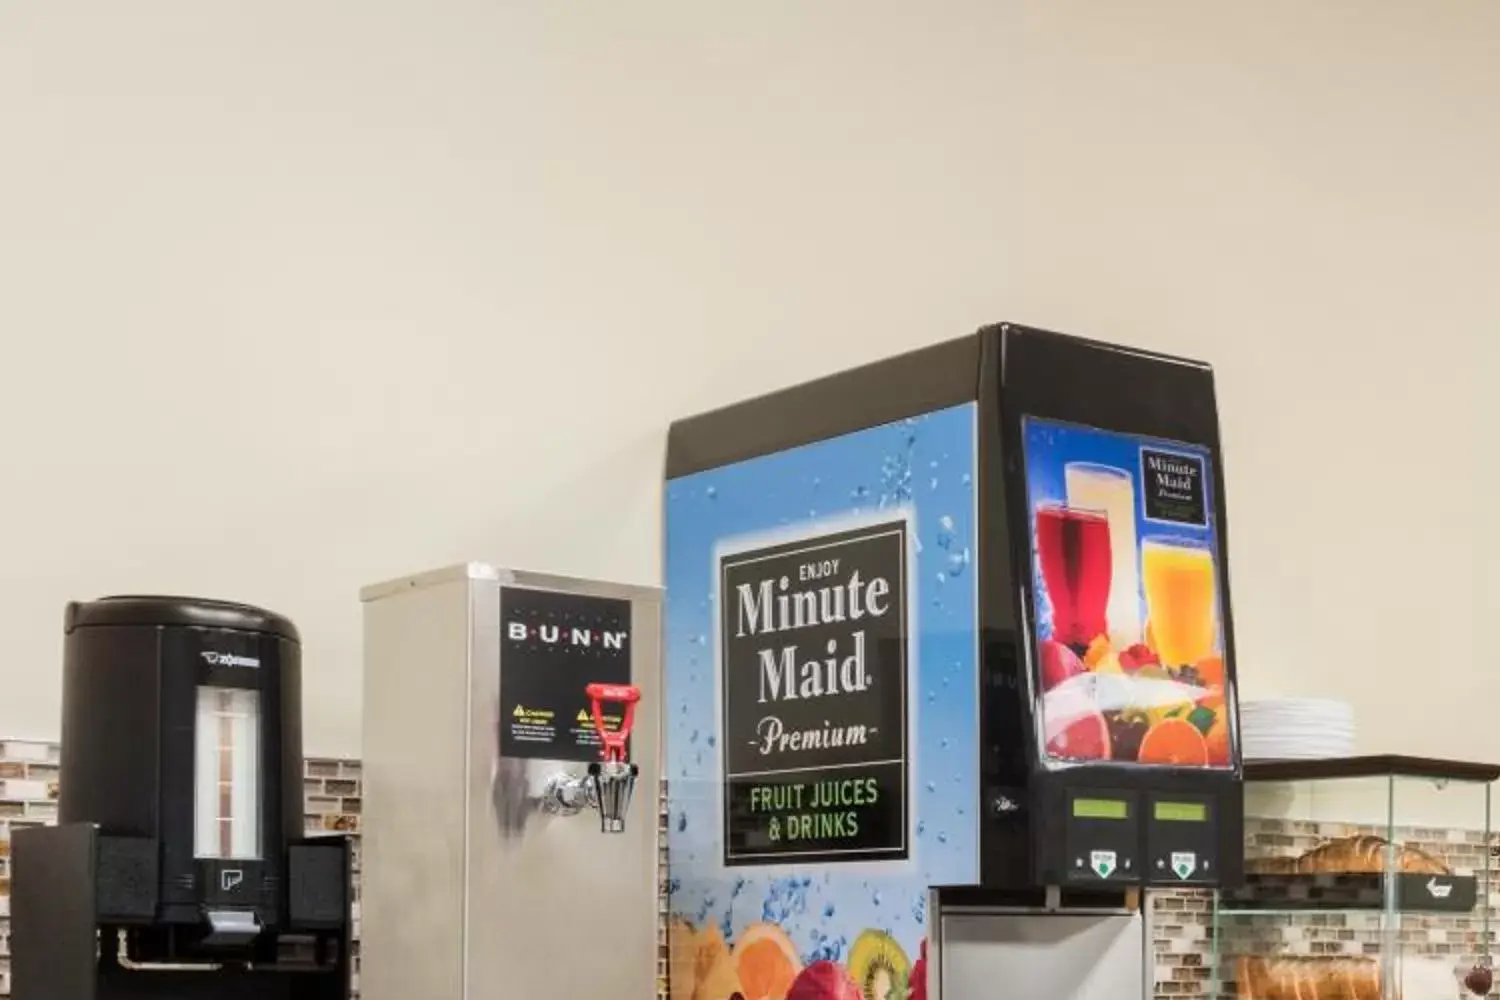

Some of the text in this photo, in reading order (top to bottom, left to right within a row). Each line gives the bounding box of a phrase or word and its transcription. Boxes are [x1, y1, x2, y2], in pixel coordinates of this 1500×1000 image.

[1148, 456, 1197, 476] Minute
[1157, 473, 1191, 491] Maid
[800, 558, 841, 581] ENJOY
[736, 568, 890, 638] Minute
[757, 630, 871, 703] Maid
[756, 716, 868, 755] Premium
[751, 778, 879, 812] FRUIT JUICES
[768, 811, 860, 842] & DRINKS
